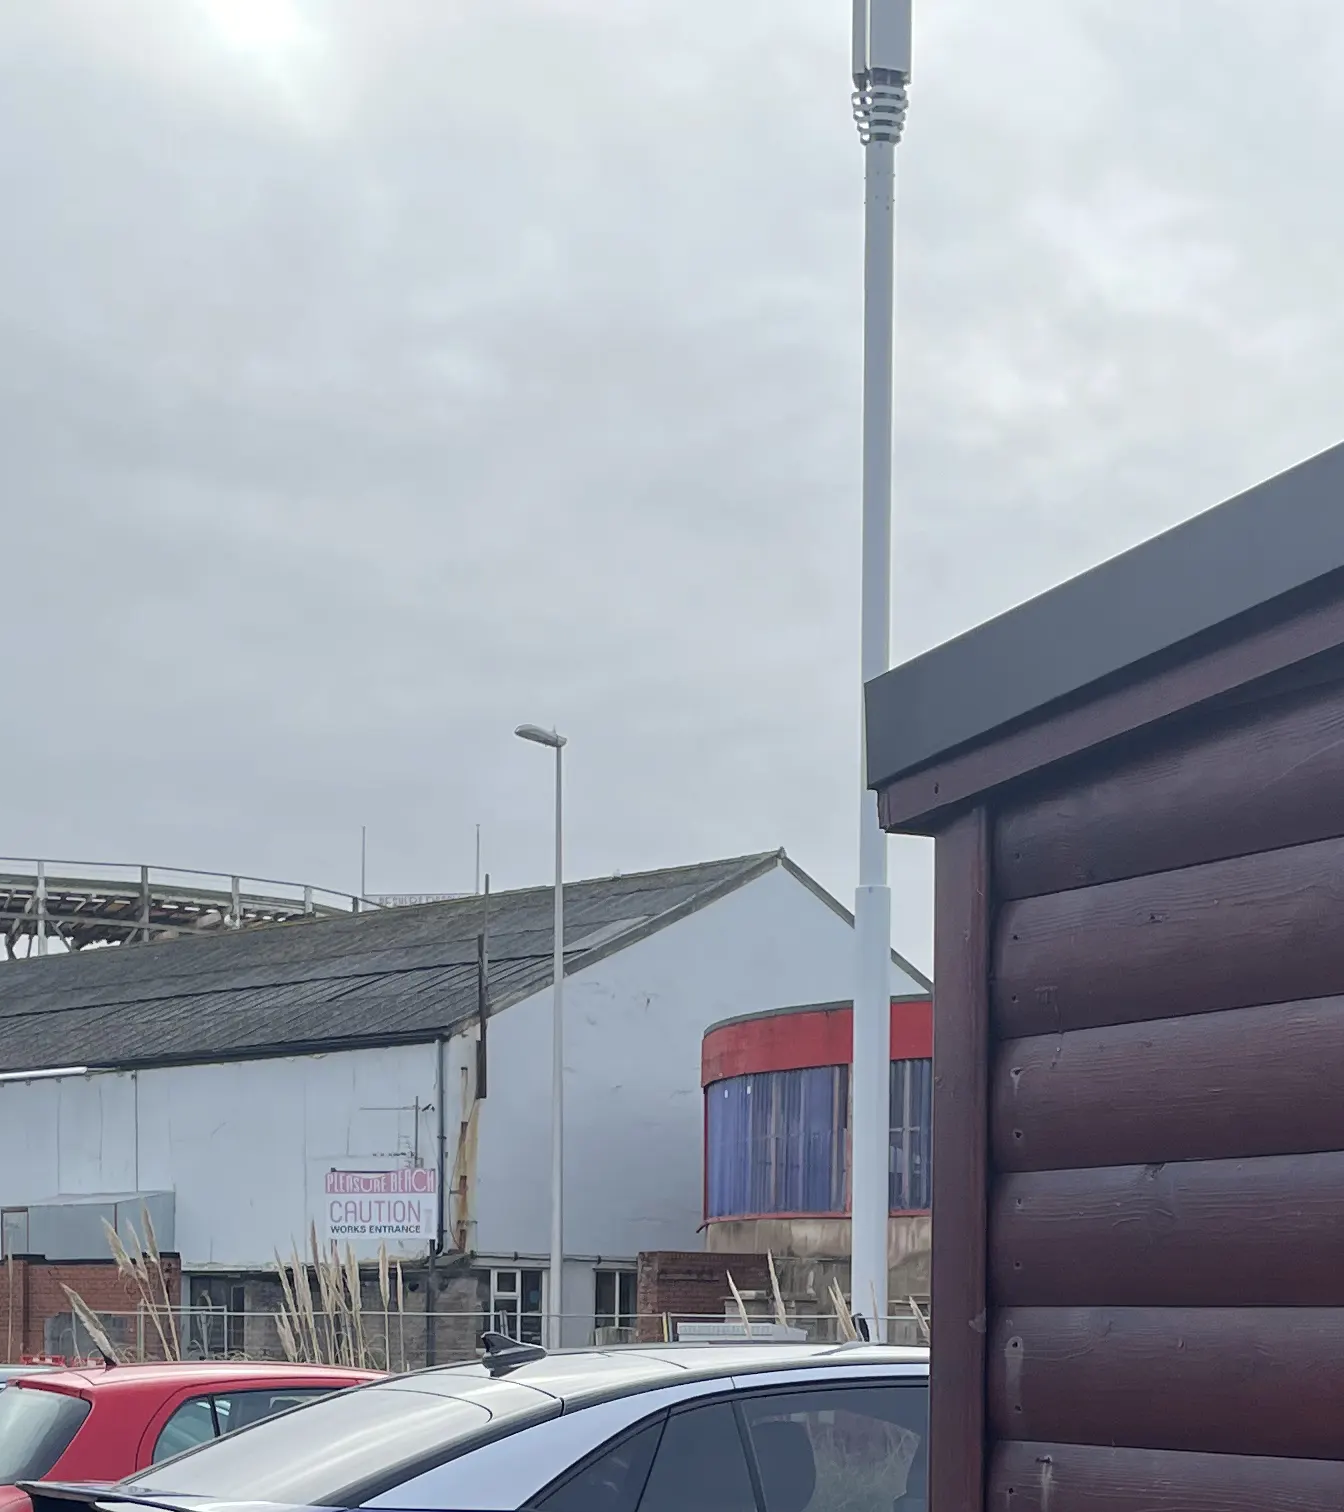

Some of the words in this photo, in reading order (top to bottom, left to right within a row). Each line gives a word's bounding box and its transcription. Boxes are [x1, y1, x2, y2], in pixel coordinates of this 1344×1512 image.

[326, 1172, 387, 1193] PLEASURE
[390, 1169, 435, 1193] BEACH
[329, 1199, 421, 1223] CAUTION
[330, 1224, 366, 1234] WORKS
[369, 1224, 421, 1234] ENTRANCE
